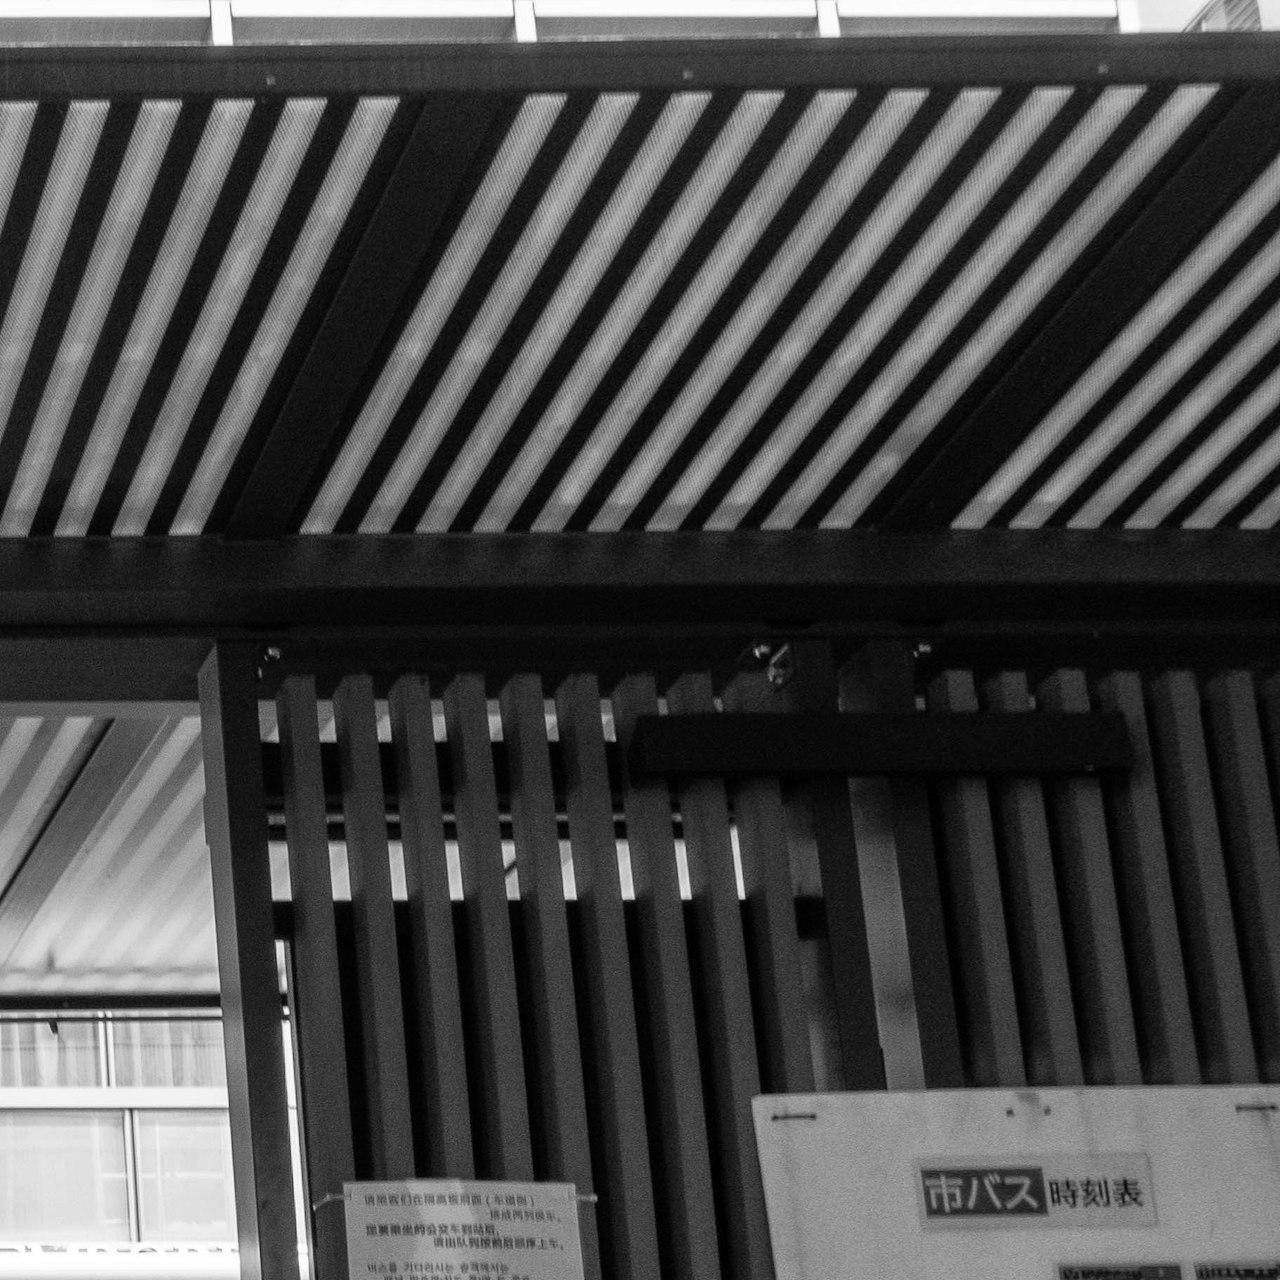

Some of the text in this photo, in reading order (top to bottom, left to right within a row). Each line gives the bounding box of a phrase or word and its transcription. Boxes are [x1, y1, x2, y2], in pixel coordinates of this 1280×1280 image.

[924, 1175, 1145, 1214] 市バス 時刻表
